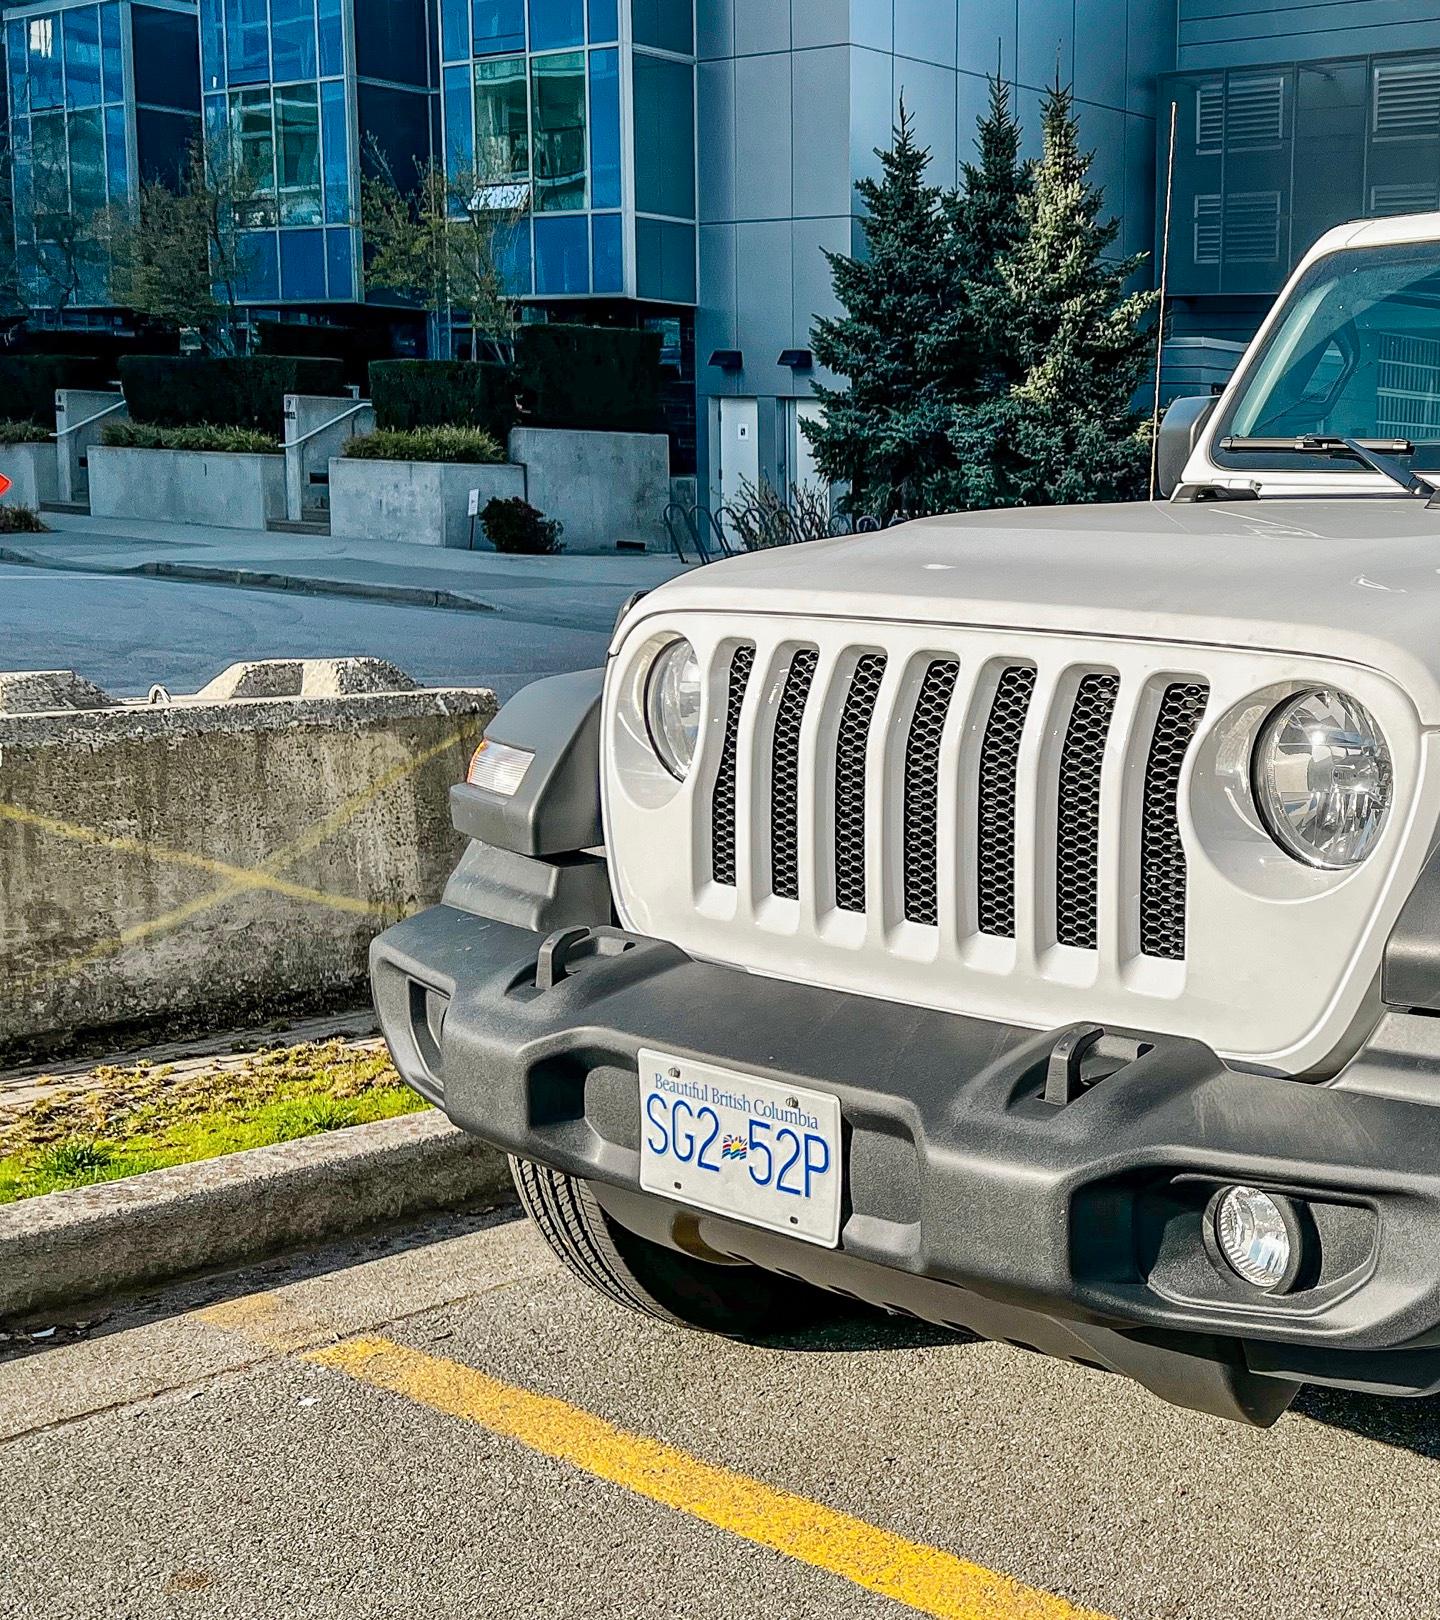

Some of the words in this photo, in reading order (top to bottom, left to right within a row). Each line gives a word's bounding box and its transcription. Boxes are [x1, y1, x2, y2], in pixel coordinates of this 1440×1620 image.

[655, 1072, 709, 1102] Beautiful
[711, 1087, 751, 1113] British
[754, 1099, 819, 1130] Columbia
[646, 1093, 721, 1172] SG2
[748, 1118, 830, 1198] 52P
